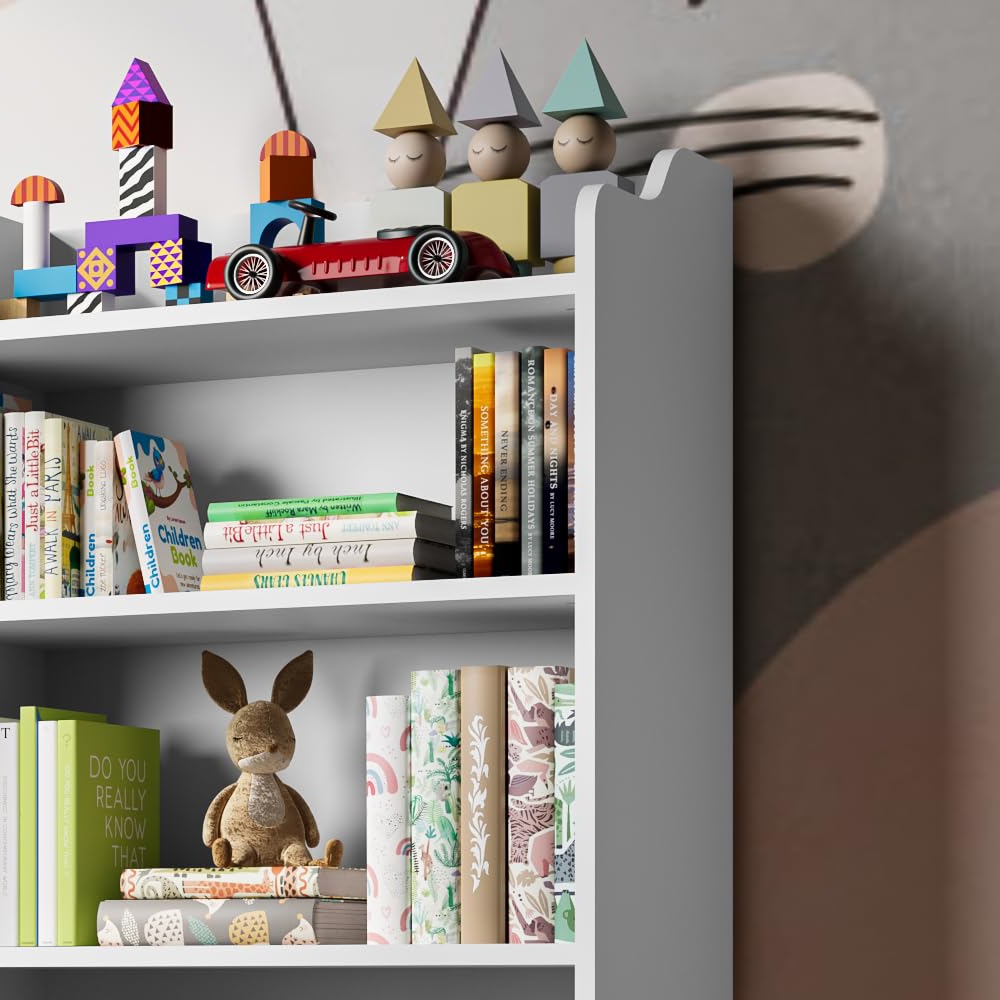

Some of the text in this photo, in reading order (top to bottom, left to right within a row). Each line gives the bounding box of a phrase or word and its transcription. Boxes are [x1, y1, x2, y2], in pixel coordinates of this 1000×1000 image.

[527, 359, 535, 418] ROMANCE
[549, 393, 558, 416] DAY
[6, 426, 18, 463] Wants
[460, 444, 467, 453] BY
[527, 435, 535, 477] SUMMER
[5, 466, 17, 484] She
[26, 428, 39, 532] Just a Little Bit
[126, 456, 139, 489] Book
[480, 405, 488, 544] SOMETHING ABOUT YOU
[500, 430, 508, 511] NEVER ENDING
[549, 447, 558, 489] NIGHTS
[7, 488, 18, 518] What
[527, 479, 535, 529] HOLIDAYS
[550, 492, 555, 500] BY
[44, 457, 62, 575] A WALK IN PARIS
[5, 522, 18, 558] Wears
[158, 525, 202, 550] Children
[222, 522, 330, 543] Just a Little Bit
[86, 534, 96, 597] Children
[142, 523, 160, 589] Children
[170, 545, 197, 567] Book
[256, 543, 372, 567] Inch by Inch
[1, 727, 10, 739] T
[89, 755, 146, 783] DO YOU
[96, 785, 146, 811] REALLY
[105, 815, 147, 839] KNOW
[112, 844, 147, 868] THAT
